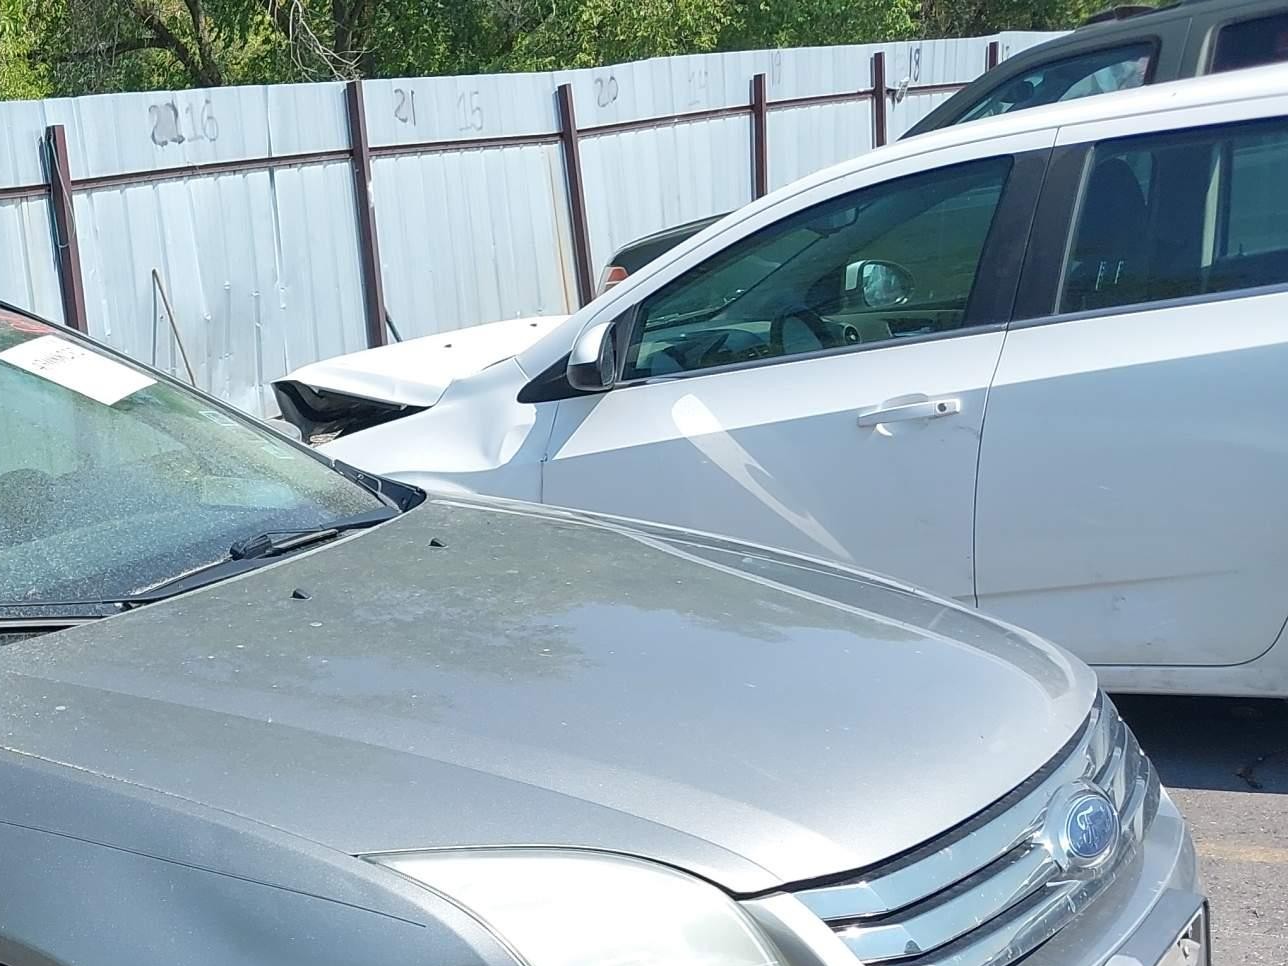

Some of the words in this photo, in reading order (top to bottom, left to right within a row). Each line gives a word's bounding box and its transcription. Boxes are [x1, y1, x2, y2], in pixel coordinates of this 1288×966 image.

[908, 46, 921, 82] 18
[394, 89, 416, 127] 21
[594, 76, 619, 107] 20
[457, 91, 484, 131] 15
